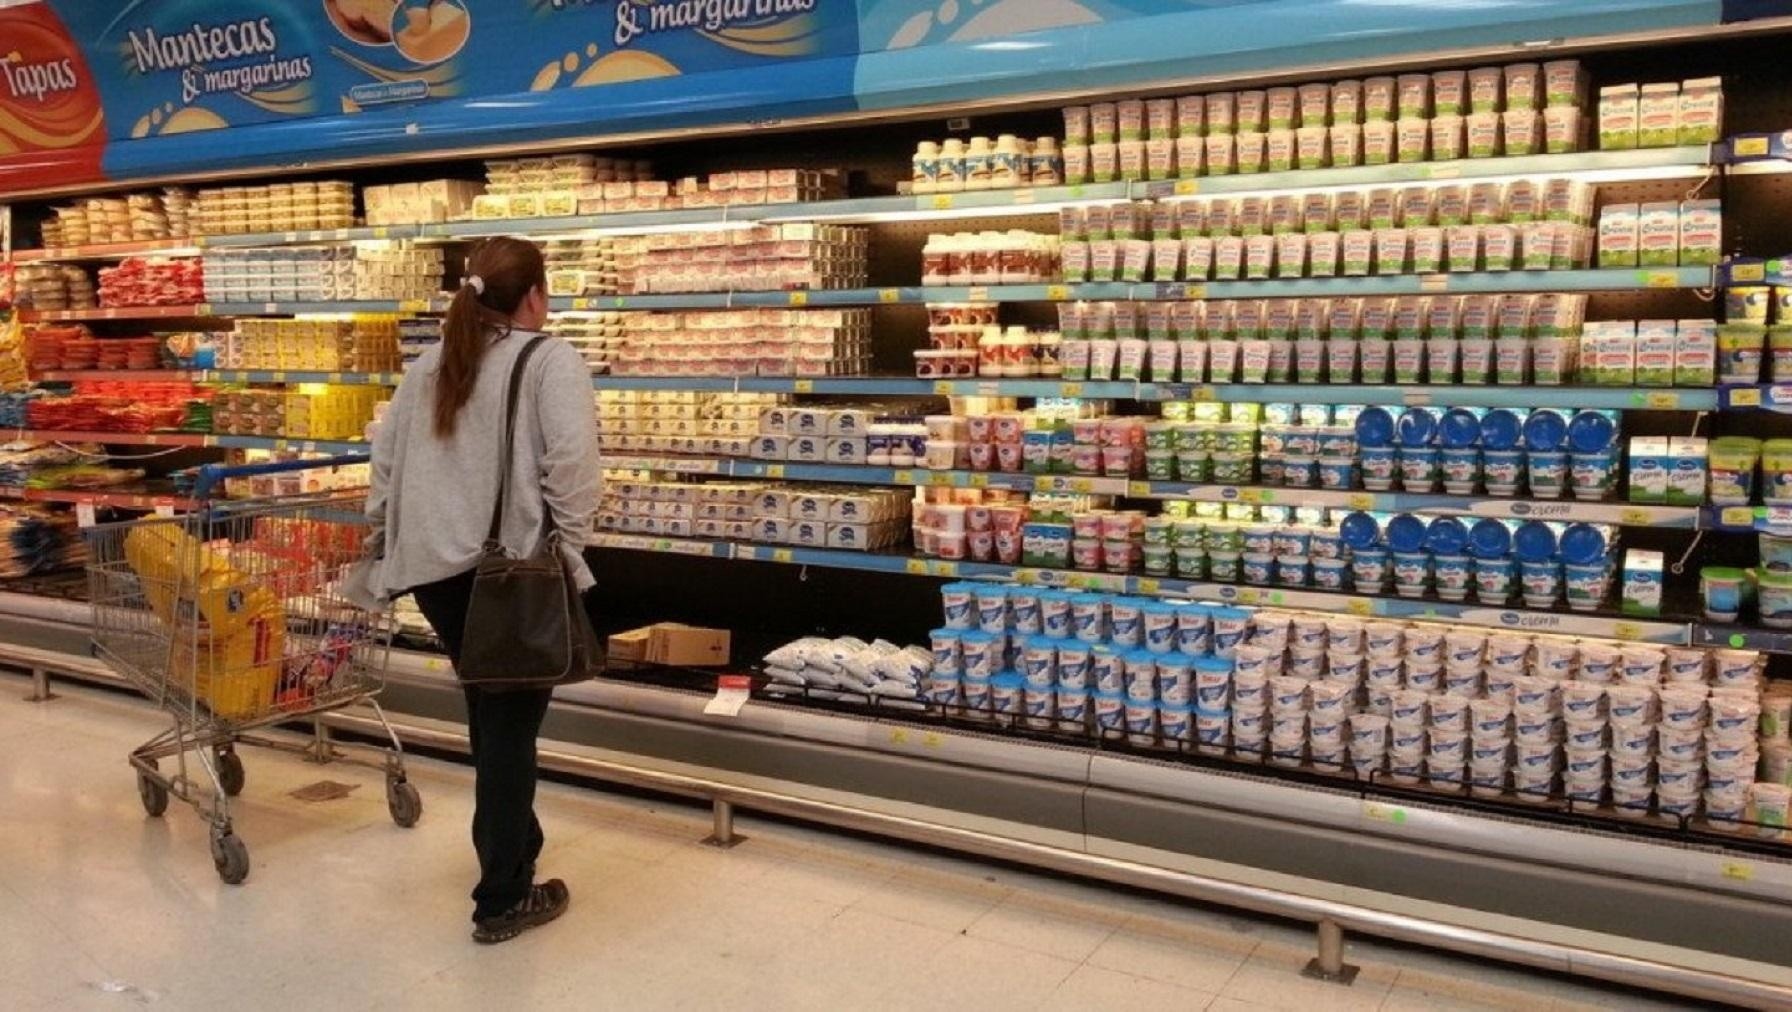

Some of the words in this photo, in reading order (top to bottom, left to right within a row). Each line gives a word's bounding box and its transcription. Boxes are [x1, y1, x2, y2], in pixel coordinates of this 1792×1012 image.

[128, 17, 275, 72] Mantecas
[614, 2, 643, 43] &
[0, 58, 77, 102] Tapas
[182, 69, 200, 104] &
[204, 55, 312, 93] margarinas
